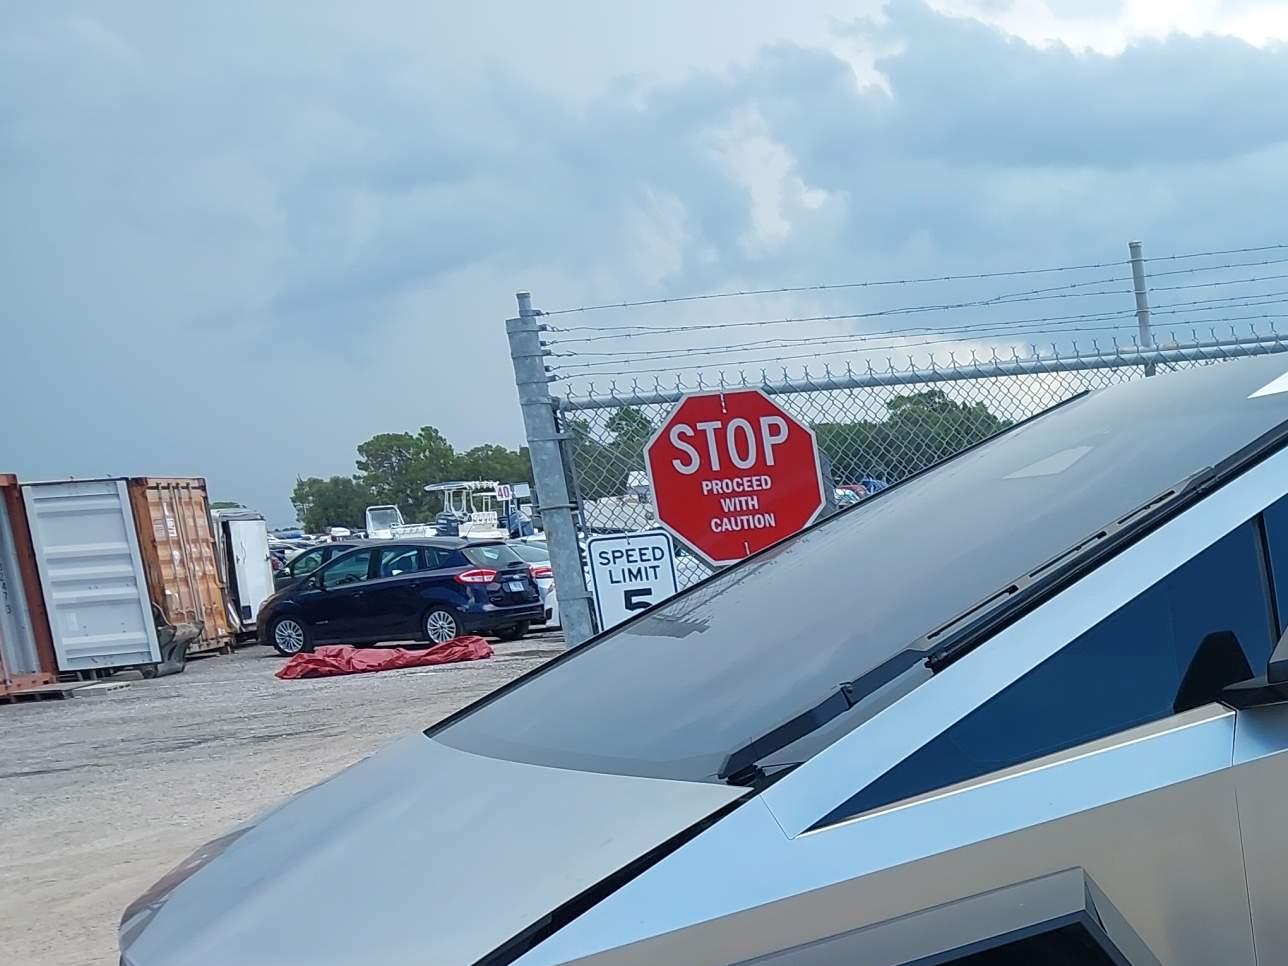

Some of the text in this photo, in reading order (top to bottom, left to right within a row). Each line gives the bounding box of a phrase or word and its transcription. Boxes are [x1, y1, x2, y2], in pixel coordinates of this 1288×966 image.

[669, 415, 790, 475] STOP
[496, 486, 510, 499] 40
[702, 475, 772, 495] PROCEED
[720, 495, 759, 513] WITH
[710, 513, 776, 533] CAUTION
[598, 546, 665, 566] SPEED
[608, 565, 660, 584] LIMIT
